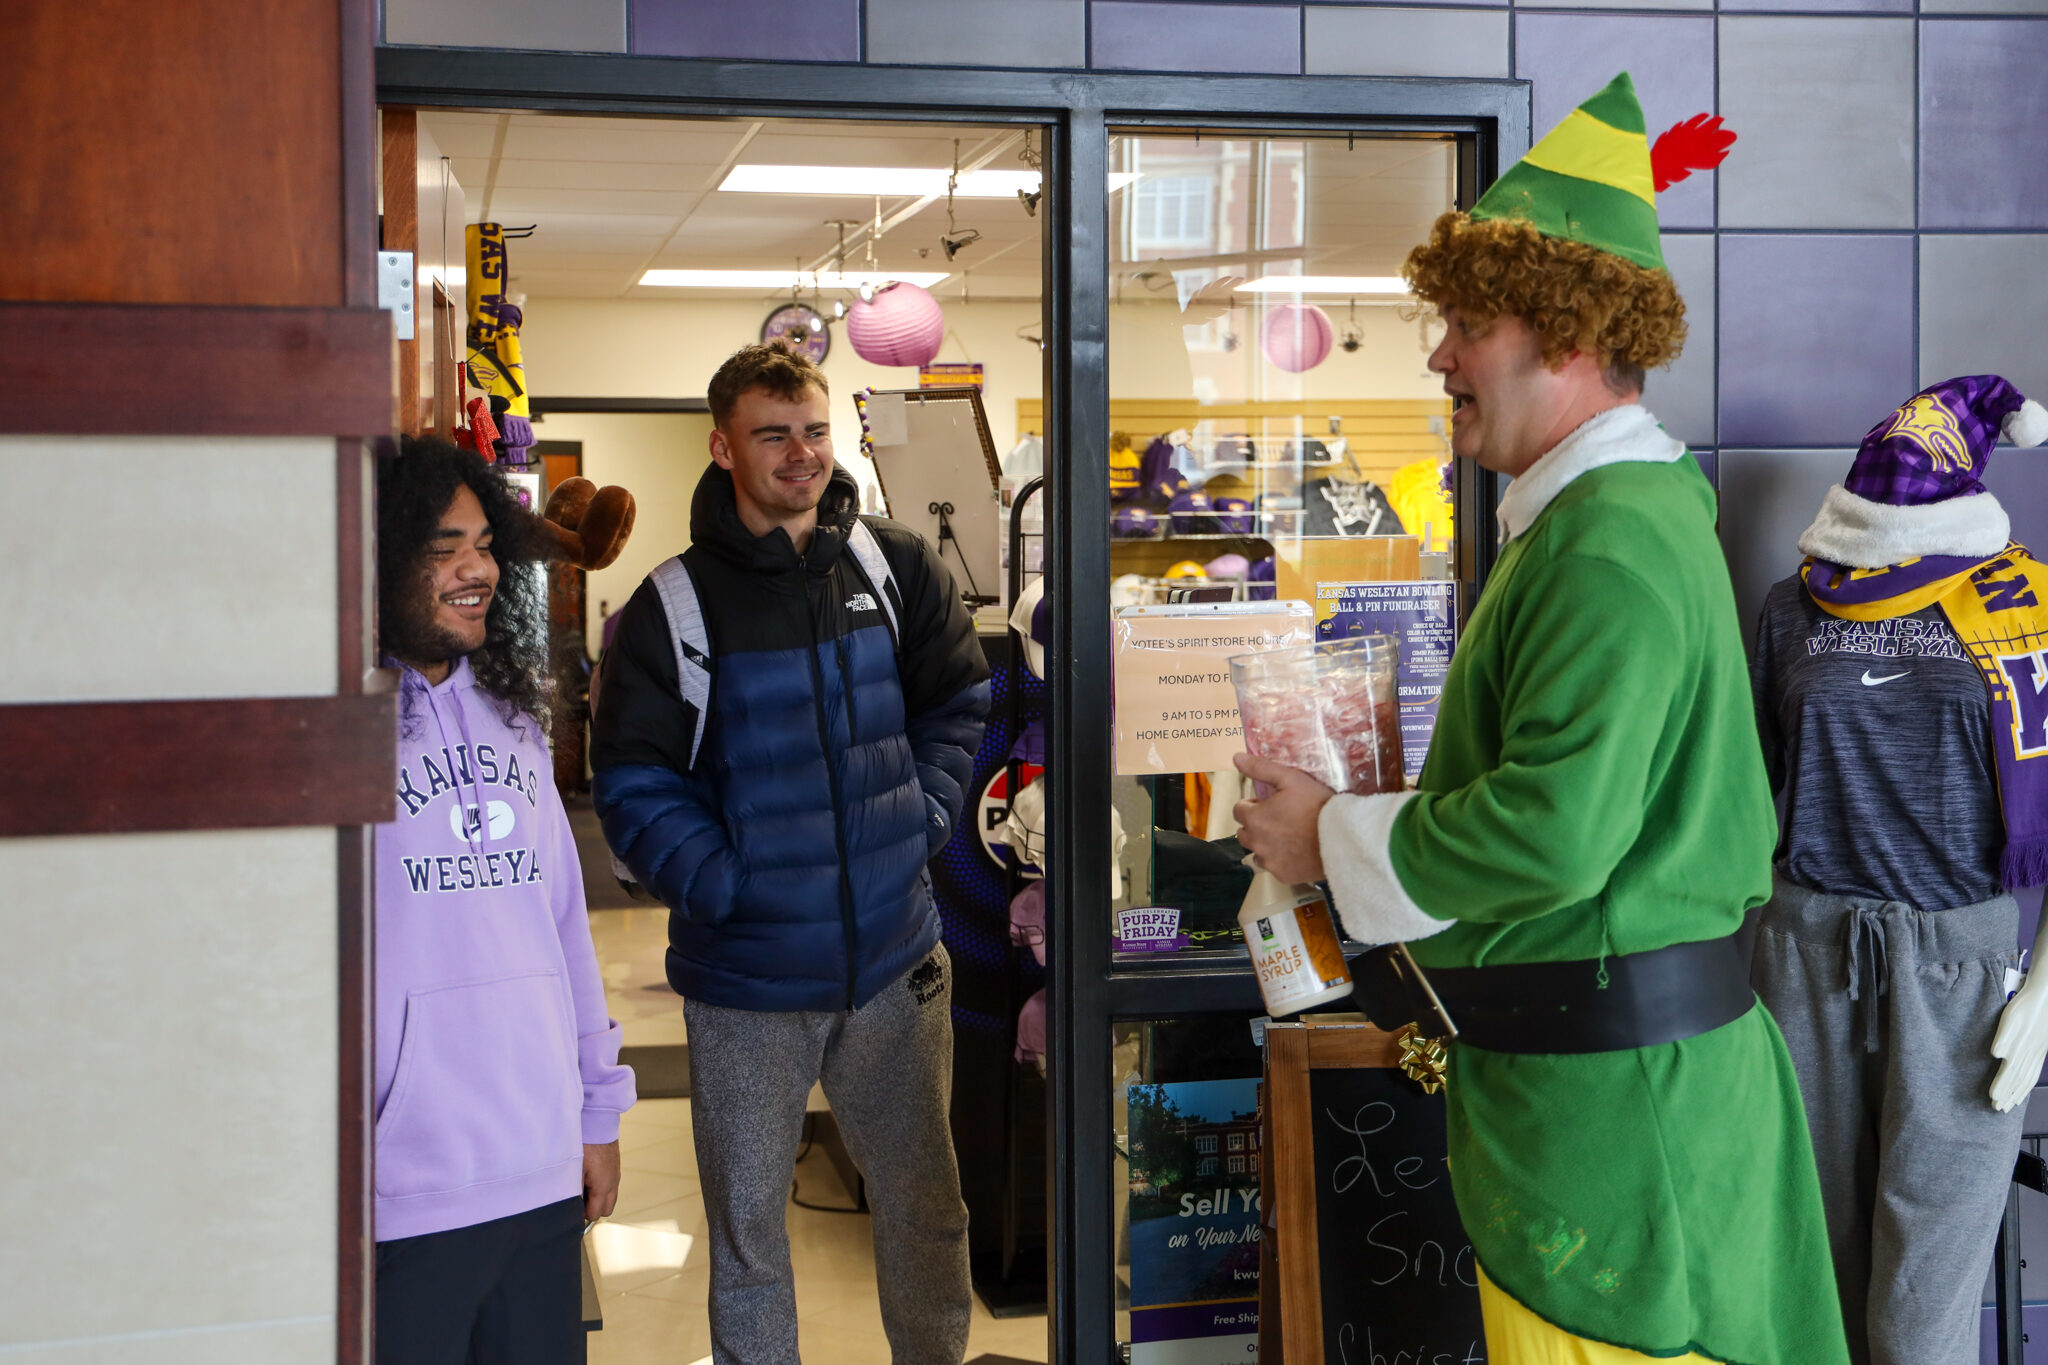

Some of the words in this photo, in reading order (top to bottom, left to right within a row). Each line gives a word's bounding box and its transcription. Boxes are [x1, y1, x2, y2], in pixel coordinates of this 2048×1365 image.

[1317, 588, 1356, 599] KANSAS
[1358, 586, 1410, 598] WESLEYAN
[1411, 585, 1453, 597] BOWLING
[845, 599, 867, 608] NORTH
[852, 604, 869, 612] FACE
[1329, 602, 1354, 613] BALL
[1356, 602, 1363, 612] &
[1365, 601, 1381, 612] PIN
[1383, 600, 1440, 612] FUNDRAISER
[1817, 617, 1956, 641] KANSA
[1131, 639, 1175, 649] YOTEE'S
[1177, 638, 1210, 648] SPIRIT
[1212, 636, 1245, 647] STORE
[1158, 674, 1205, 685] MONDAY
[1207, 673, 1221, 683] TO
[1162, 712, 1168, 721] 9
[1171, 711, 1187, 720] AM
[1189, 710, 1203, 720] TO
[1205, 710, 1212, 719] 5
[1214, 709, 1230, 719] PM
[1136, 730, 1169, 740] HOME
[1171, 728, 1223, 739] GAMEDAY
[397, 743, 537, 818] KANSAS
[1122, 914, 1177, 927] PURPLE
[1123, 926, 1175, 939] FRIDAY
[1257, 945, 1302, 969] MAPLE
[1261, 959, 1302, 982] SYRUP
[1326, 1101, 1449, 1198] Le
[1179, 1188, 1230, 1217] Sell
[1168, 1234, 1189, 1248] on
[1195, 1226, 1238, 1250] Your
[1213, 1315, 1236, 1325] Free
